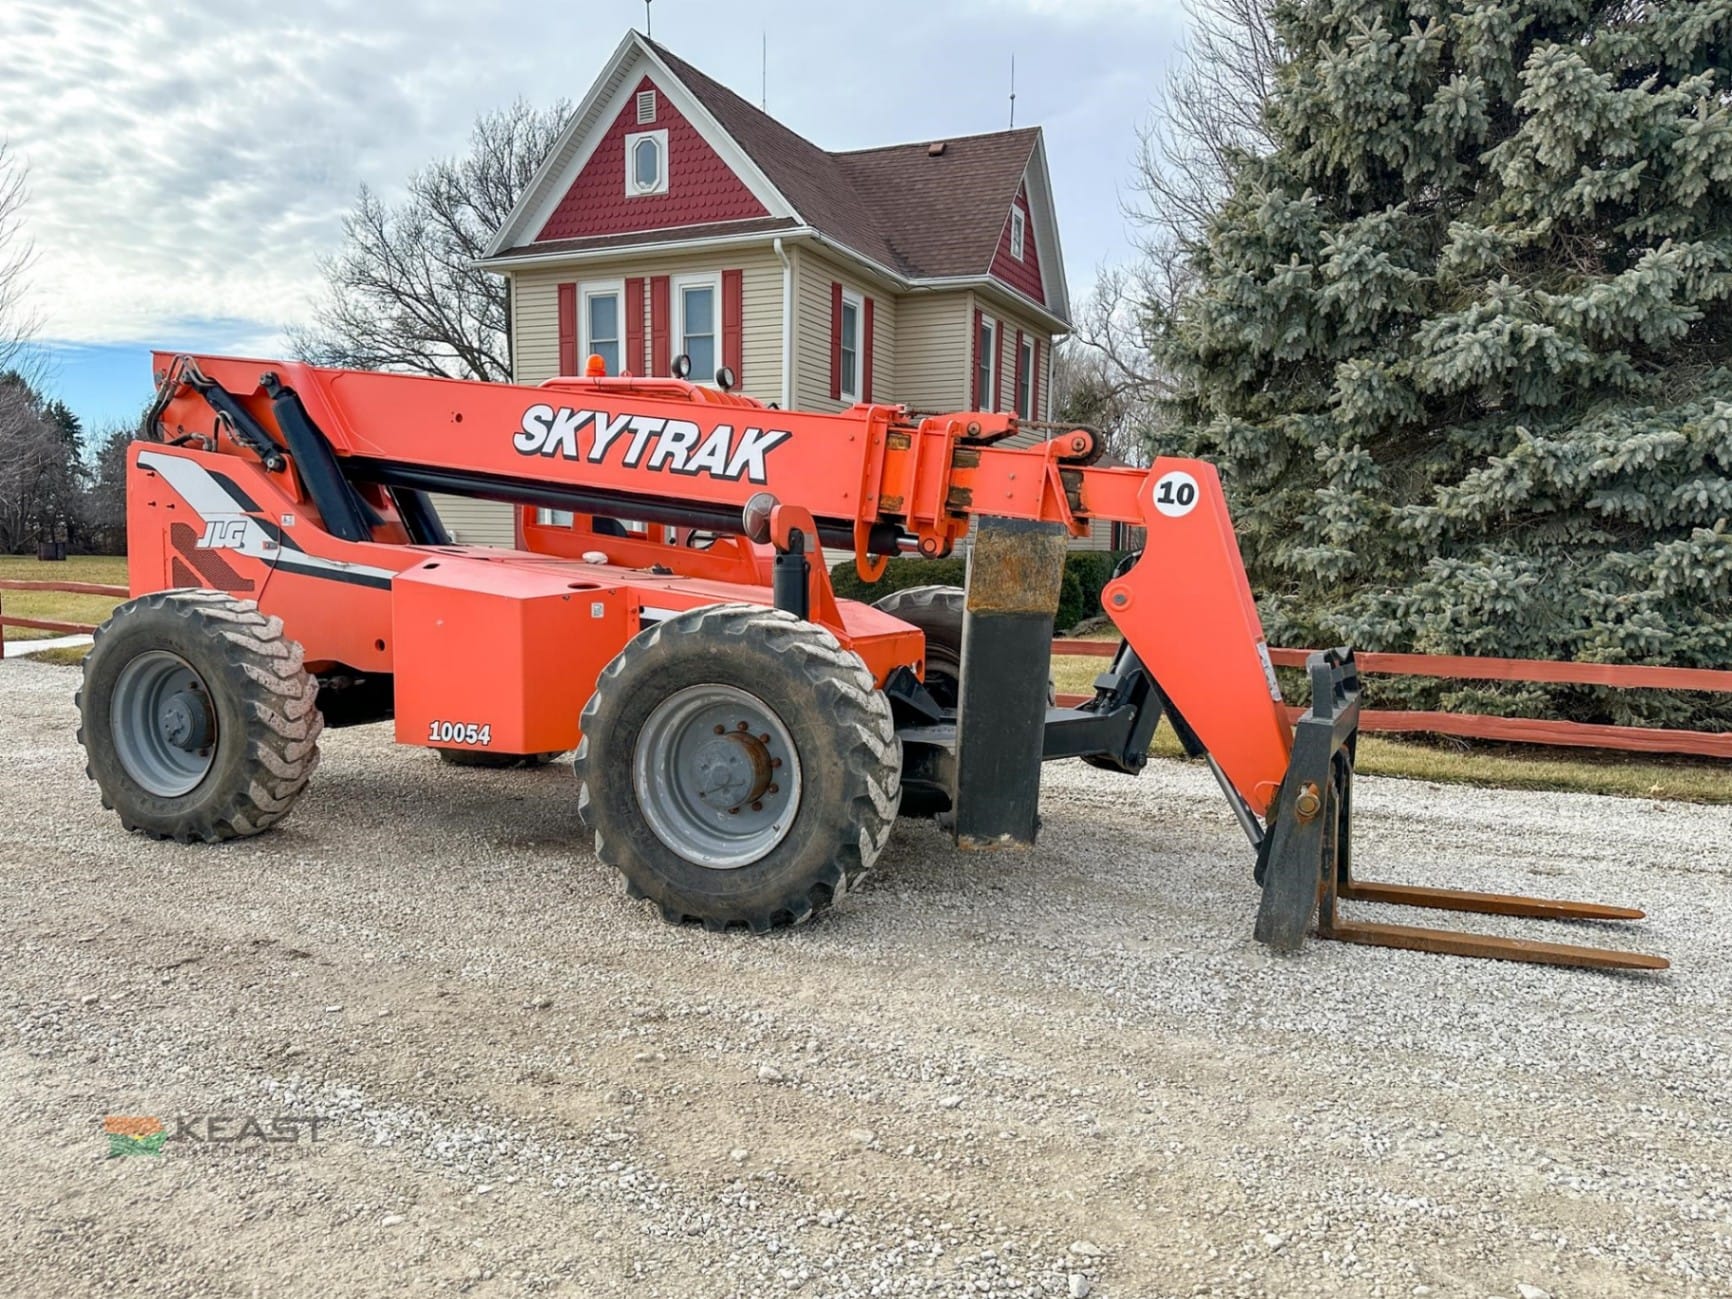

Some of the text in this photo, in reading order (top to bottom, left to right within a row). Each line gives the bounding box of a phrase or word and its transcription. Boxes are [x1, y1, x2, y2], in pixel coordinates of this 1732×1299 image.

[512, 404, 792, 485] SKYTRAK
[1157, 481, 1195, 506] 10
[196, 520, 248, 549] JLG
[428, 720, 491, 746] 10054
